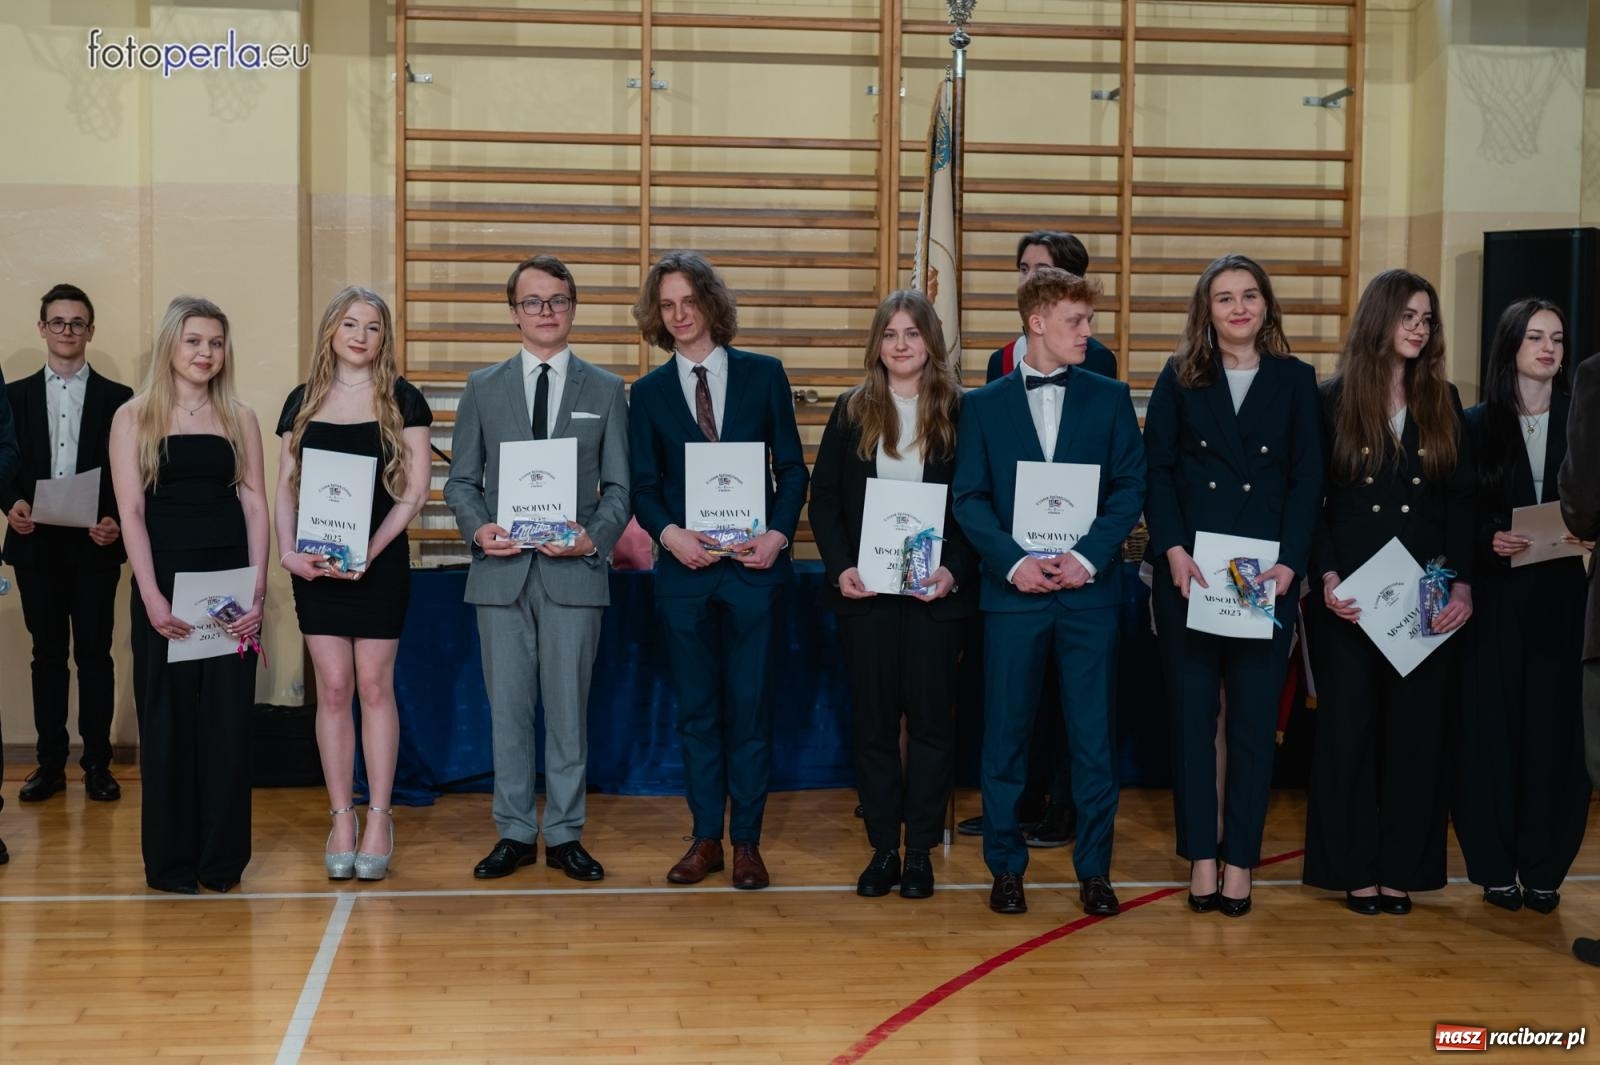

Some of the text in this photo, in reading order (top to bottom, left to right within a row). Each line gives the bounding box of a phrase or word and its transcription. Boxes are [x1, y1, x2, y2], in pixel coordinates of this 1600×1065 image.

[511, 503, 562, 513] ABSOLWENT
[700, 509, 750, 518] ABSOLWENT
[311, 516, 356, 531] ABSOLWENT
[322, 533, 342, 543] 2025
[1217, 608, 1242, 618] 2025
